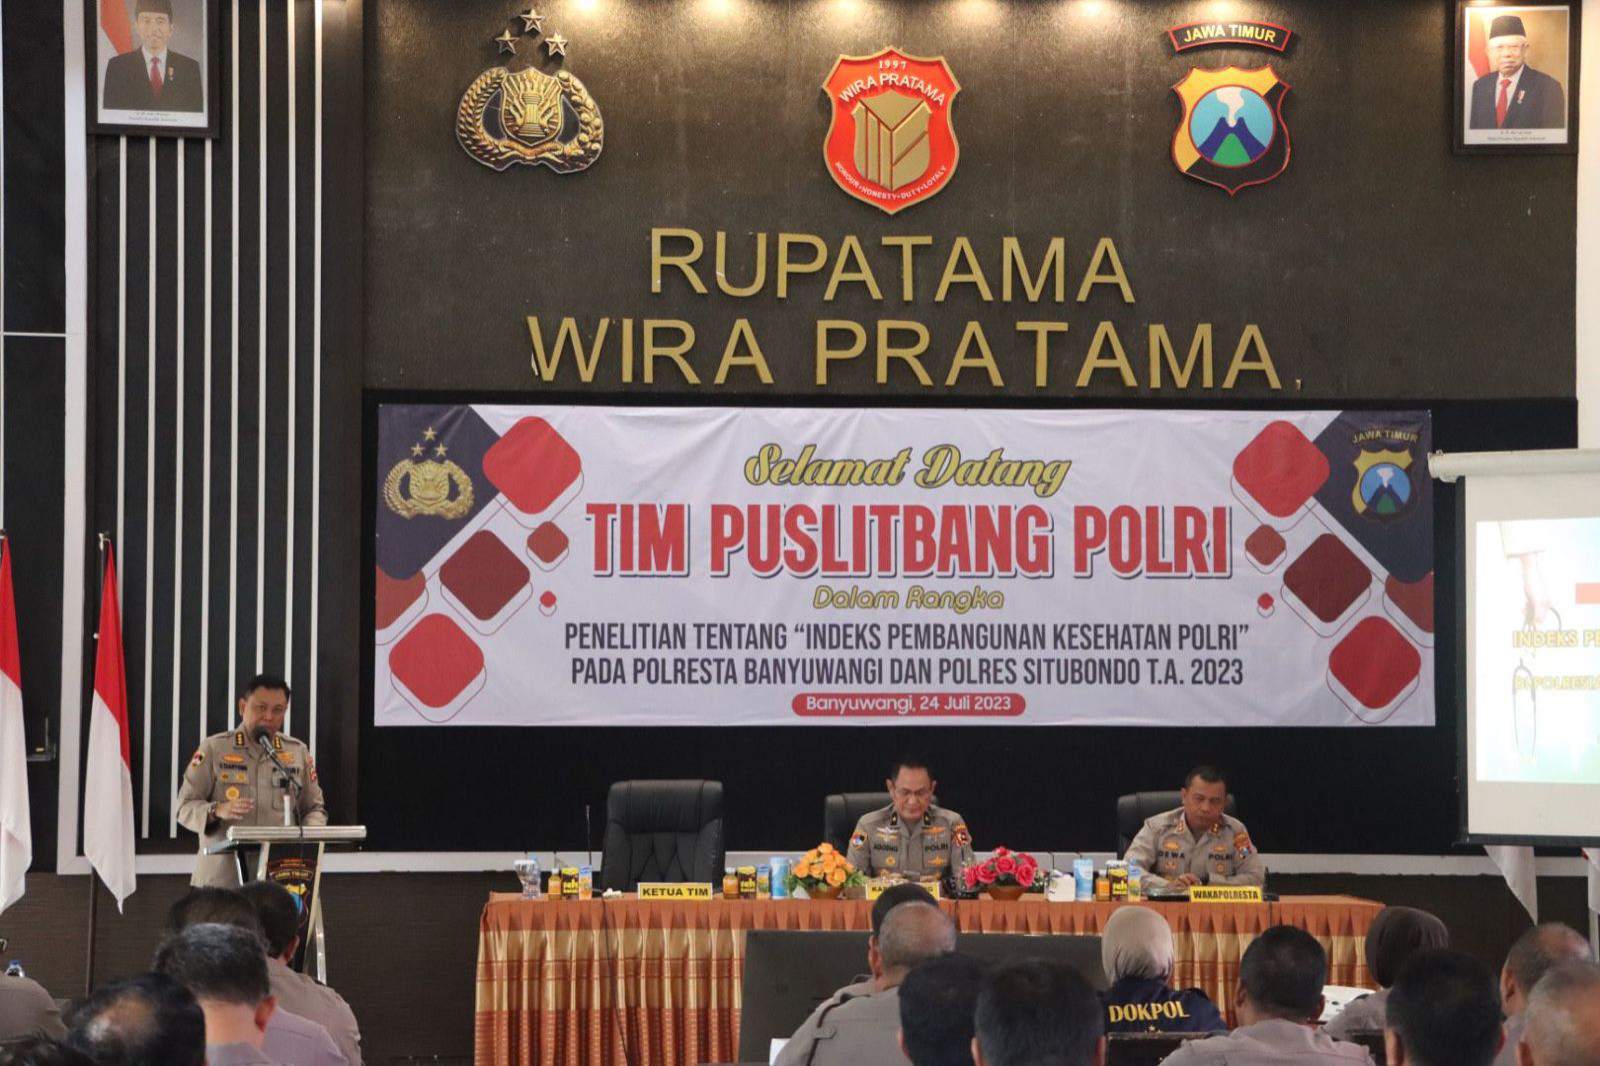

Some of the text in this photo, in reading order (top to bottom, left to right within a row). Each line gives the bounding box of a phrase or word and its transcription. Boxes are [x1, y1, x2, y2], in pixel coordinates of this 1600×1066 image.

[1184, 24, 1276, 43] JAWA TIMUR
[879, 60, 907, 69] 1997
[840, 73, 945, 106] WIRA PRATAMA
[651, 227, 1136, 304] RUPATAMA
[527, 315, 1283, 390] WIRA PRATAMA
[744, 443, 1072, 498] Selamat Datang
[585, 503, 1233, 580] TIM PUSLITBANG POLRI
[813, 585, 1005, 614] Dalam Rangka
[565, 622, 686, 650] PENELITIAN
[693, 622, 788, 650] TENTANG
[888, 623, 1046, 650] PEMBANGUNAN
[1053, 623, 1171, 651] KESEHATAN
[571, 657, 1244, 685] PADA POLRESTA BANYUWANGI DAN POLRES SITUBONDO T.A. 2023
[806, 696, 1012, 714] Banyuwangi, 24 Juli 2023
[1158, 850, 1185, 858] DEWA
[642, 887, 709, 896] KETUA TIM
[1193, 890, 1259, 900] WAKAPOLRESTA
[1108, 1000, 1191, 1023] DOKPOL
